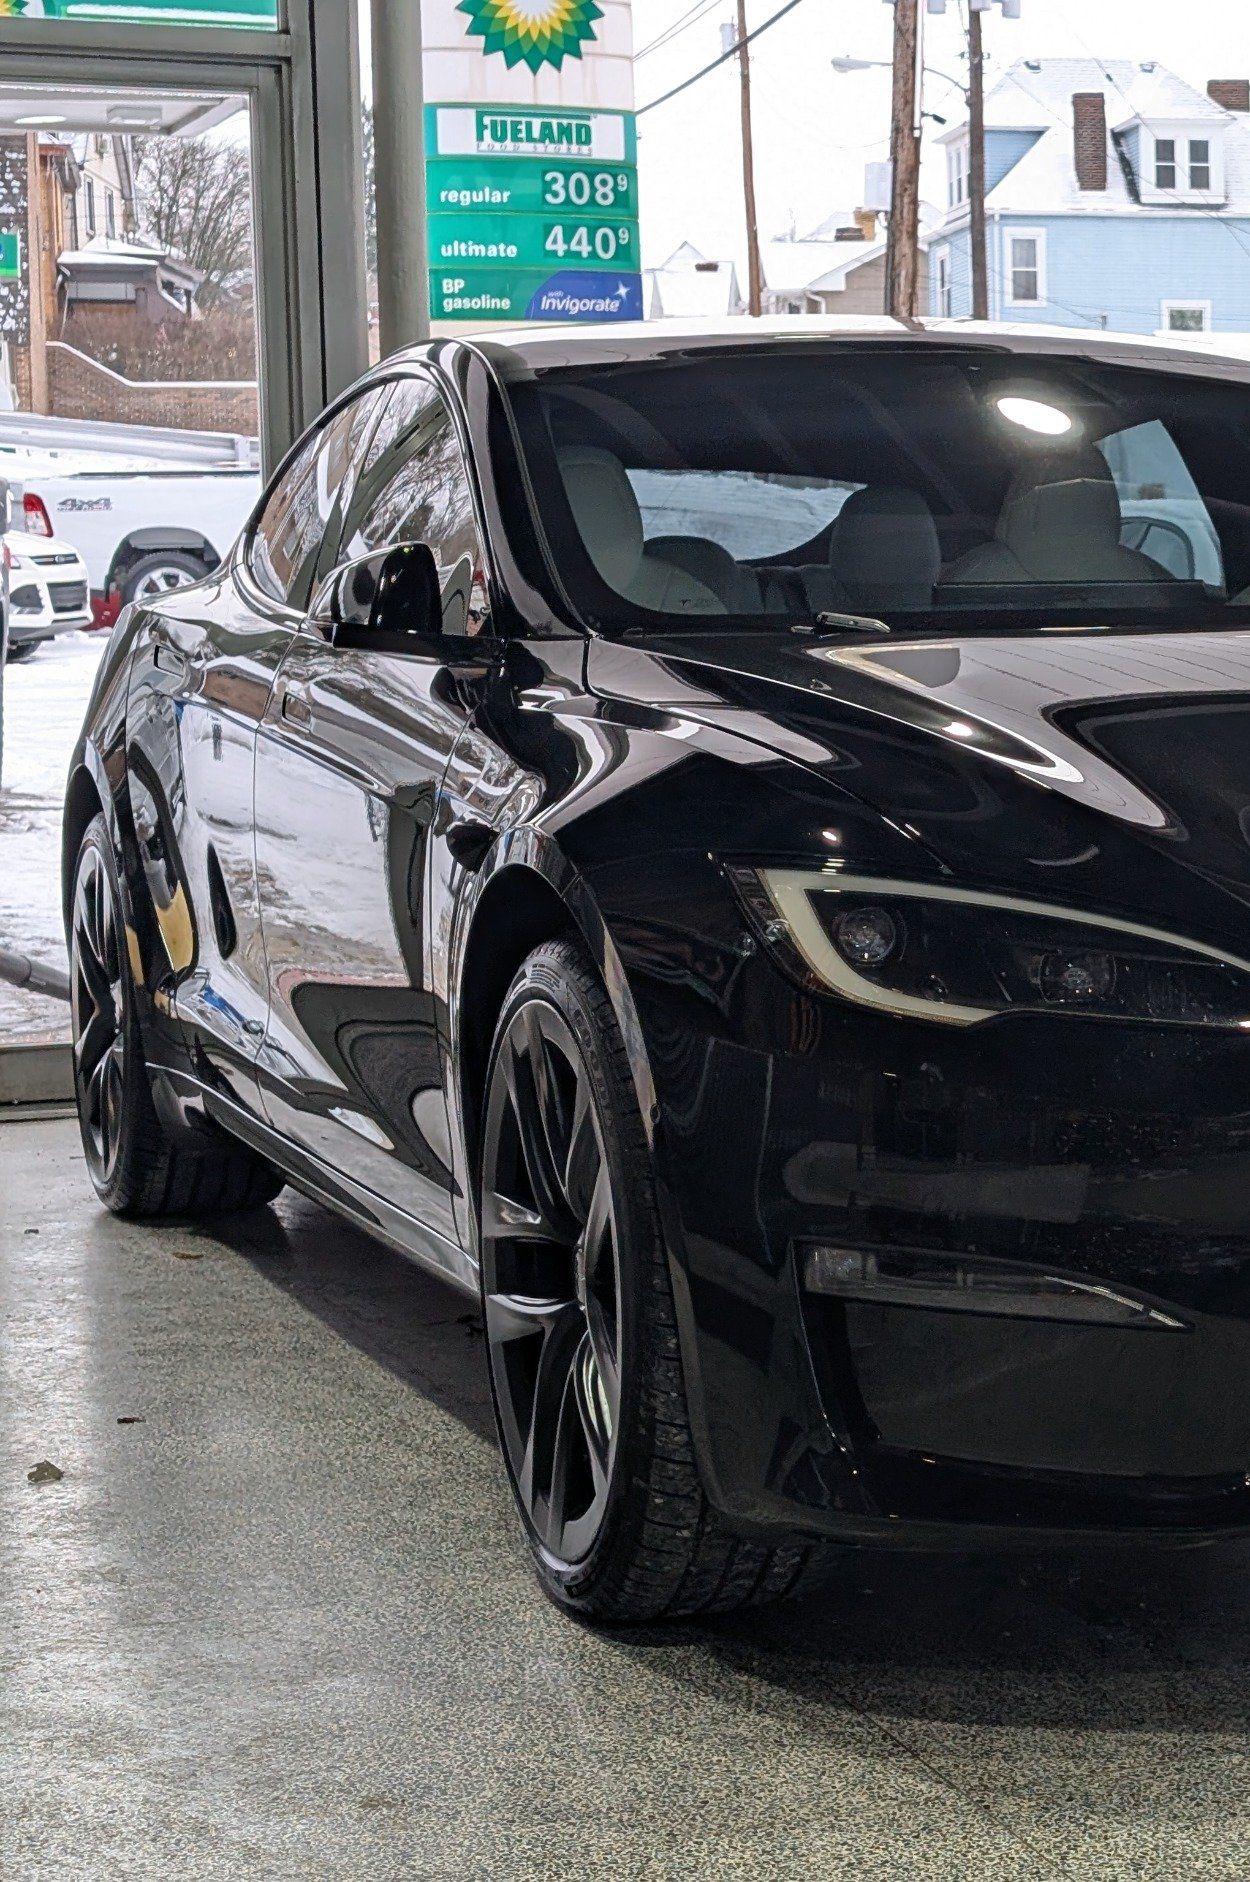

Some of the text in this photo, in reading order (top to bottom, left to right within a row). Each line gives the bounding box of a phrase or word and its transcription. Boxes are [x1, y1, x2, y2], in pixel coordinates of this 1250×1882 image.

[475, 110, 592, 146] FUELAND
[440, 186, 511, 206] regular
[440, 240, 518, 258] ultimate
[442, 278, 466, 294] BP
[443, 294, 512, 312] gasoline
